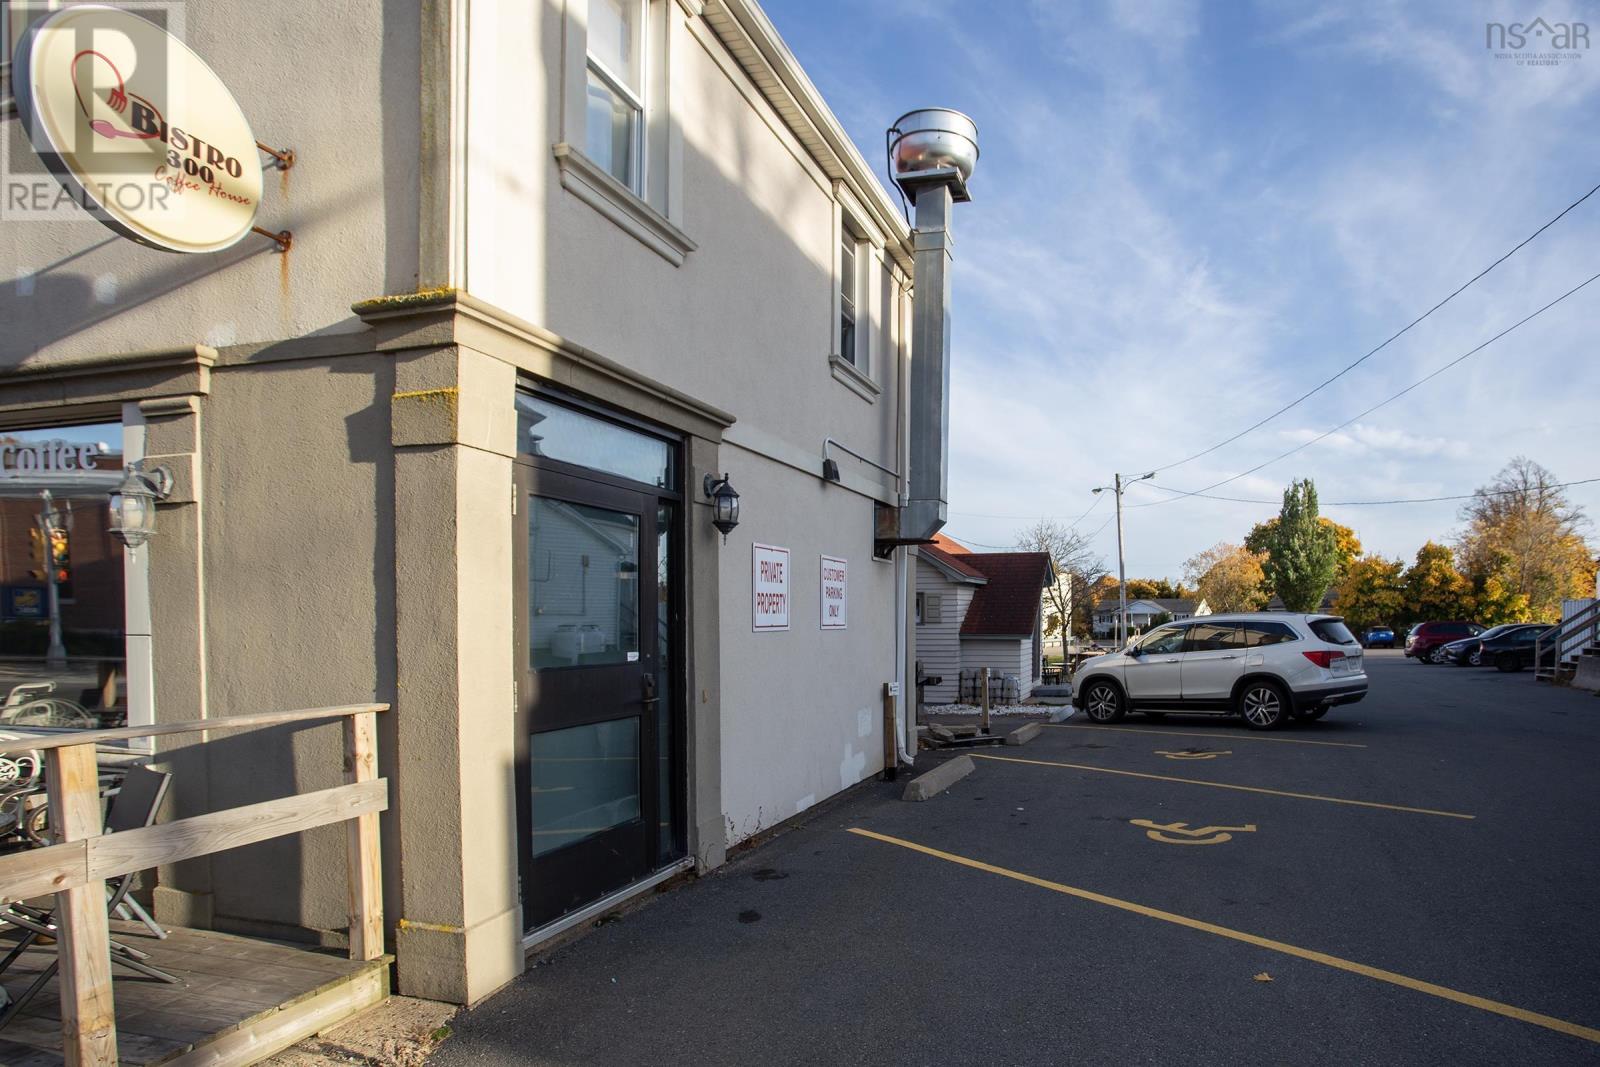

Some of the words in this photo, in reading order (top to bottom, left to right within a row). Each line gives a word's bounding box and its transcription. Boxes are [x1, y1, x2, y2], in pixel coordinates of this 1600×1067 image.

[131, 101, 242, 178] BISTRO
[166, 149, 214, 184] 300
[154, 165, 201, 195] Coffee
[208, 182, 252, 205] House
[760, 560, 783, 583] PRIVATE
[823, 568, 844, 582] CUSTOMER
[756, 592, 786, 614] PROPERTY
[825, 586, 842, 599] PARKING
[829, 604, 839, 617] ONLY
